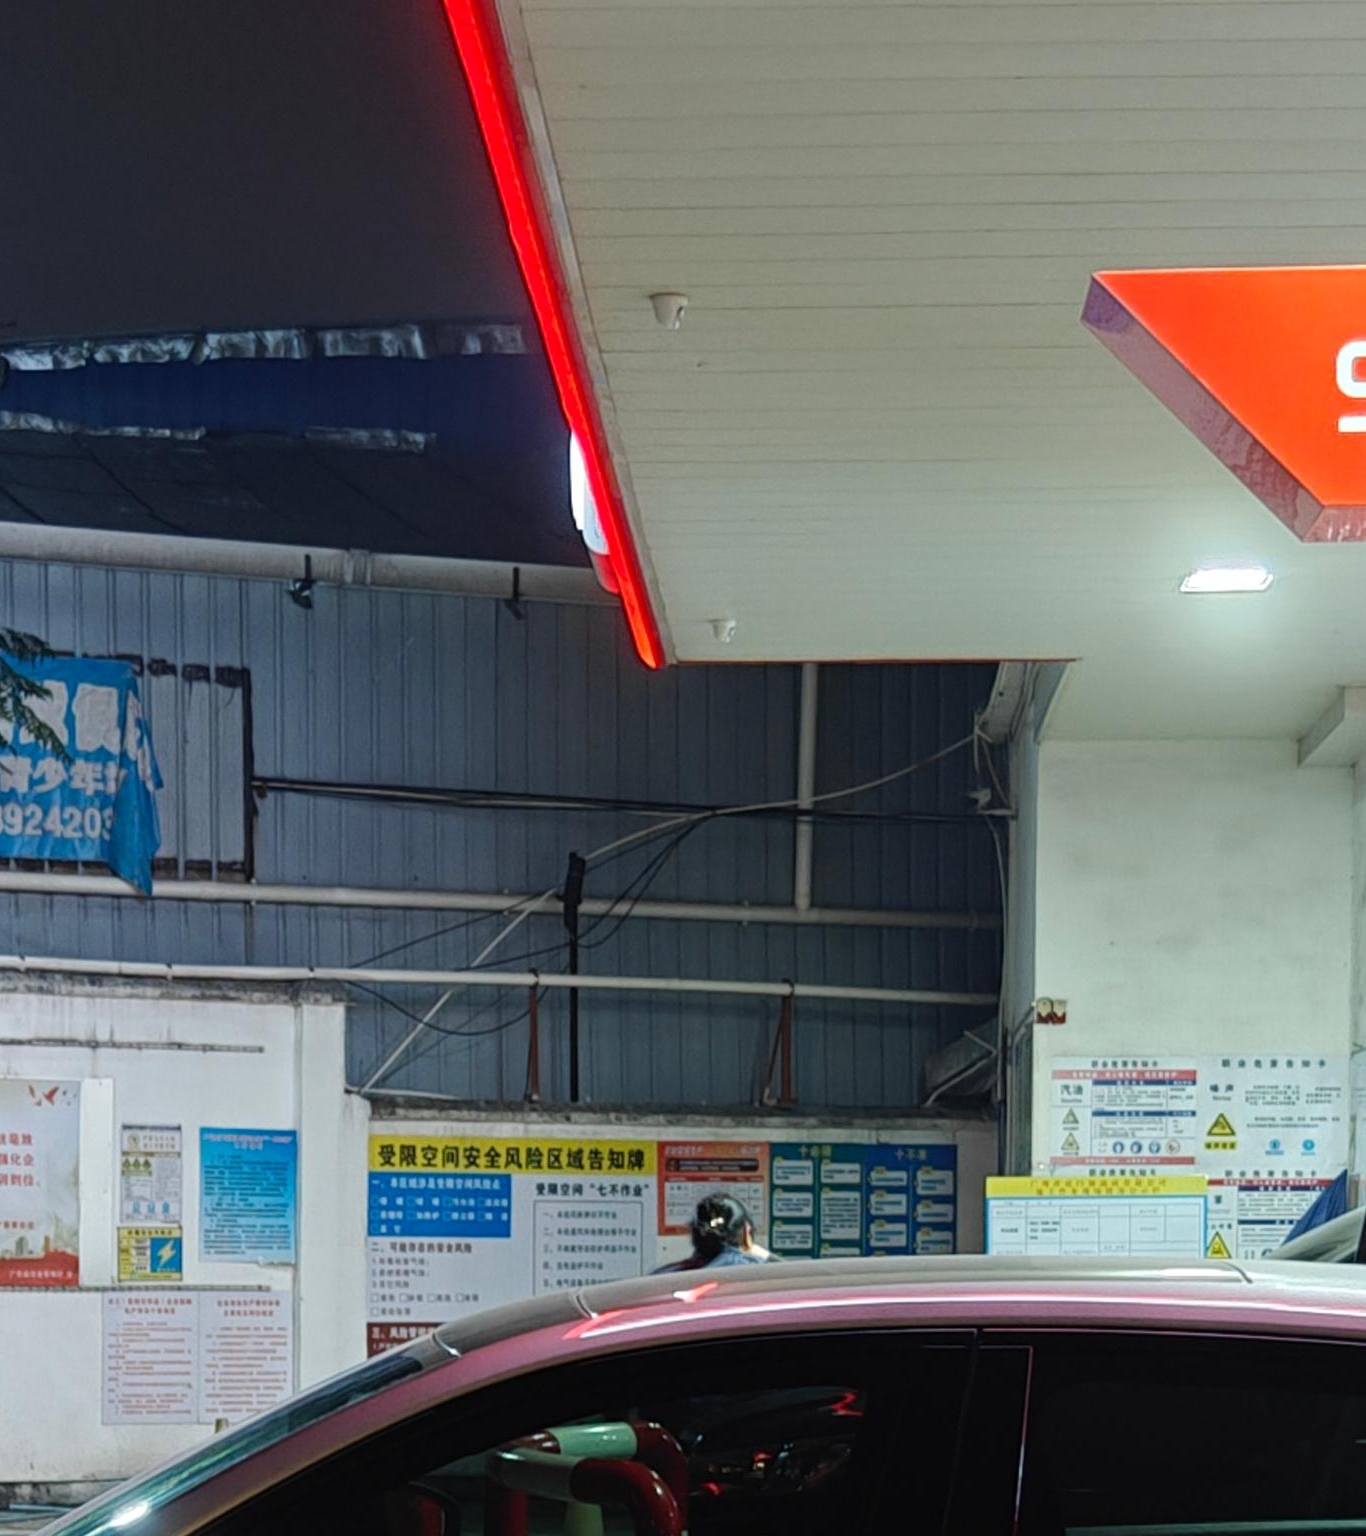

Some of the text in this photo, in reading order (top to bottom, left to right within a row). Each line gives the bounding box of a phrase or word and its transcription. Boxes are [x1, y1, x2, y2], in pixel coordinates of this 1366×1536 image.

[378, 1144, 645, 1170] 受限空间安全风险区域告知牌
